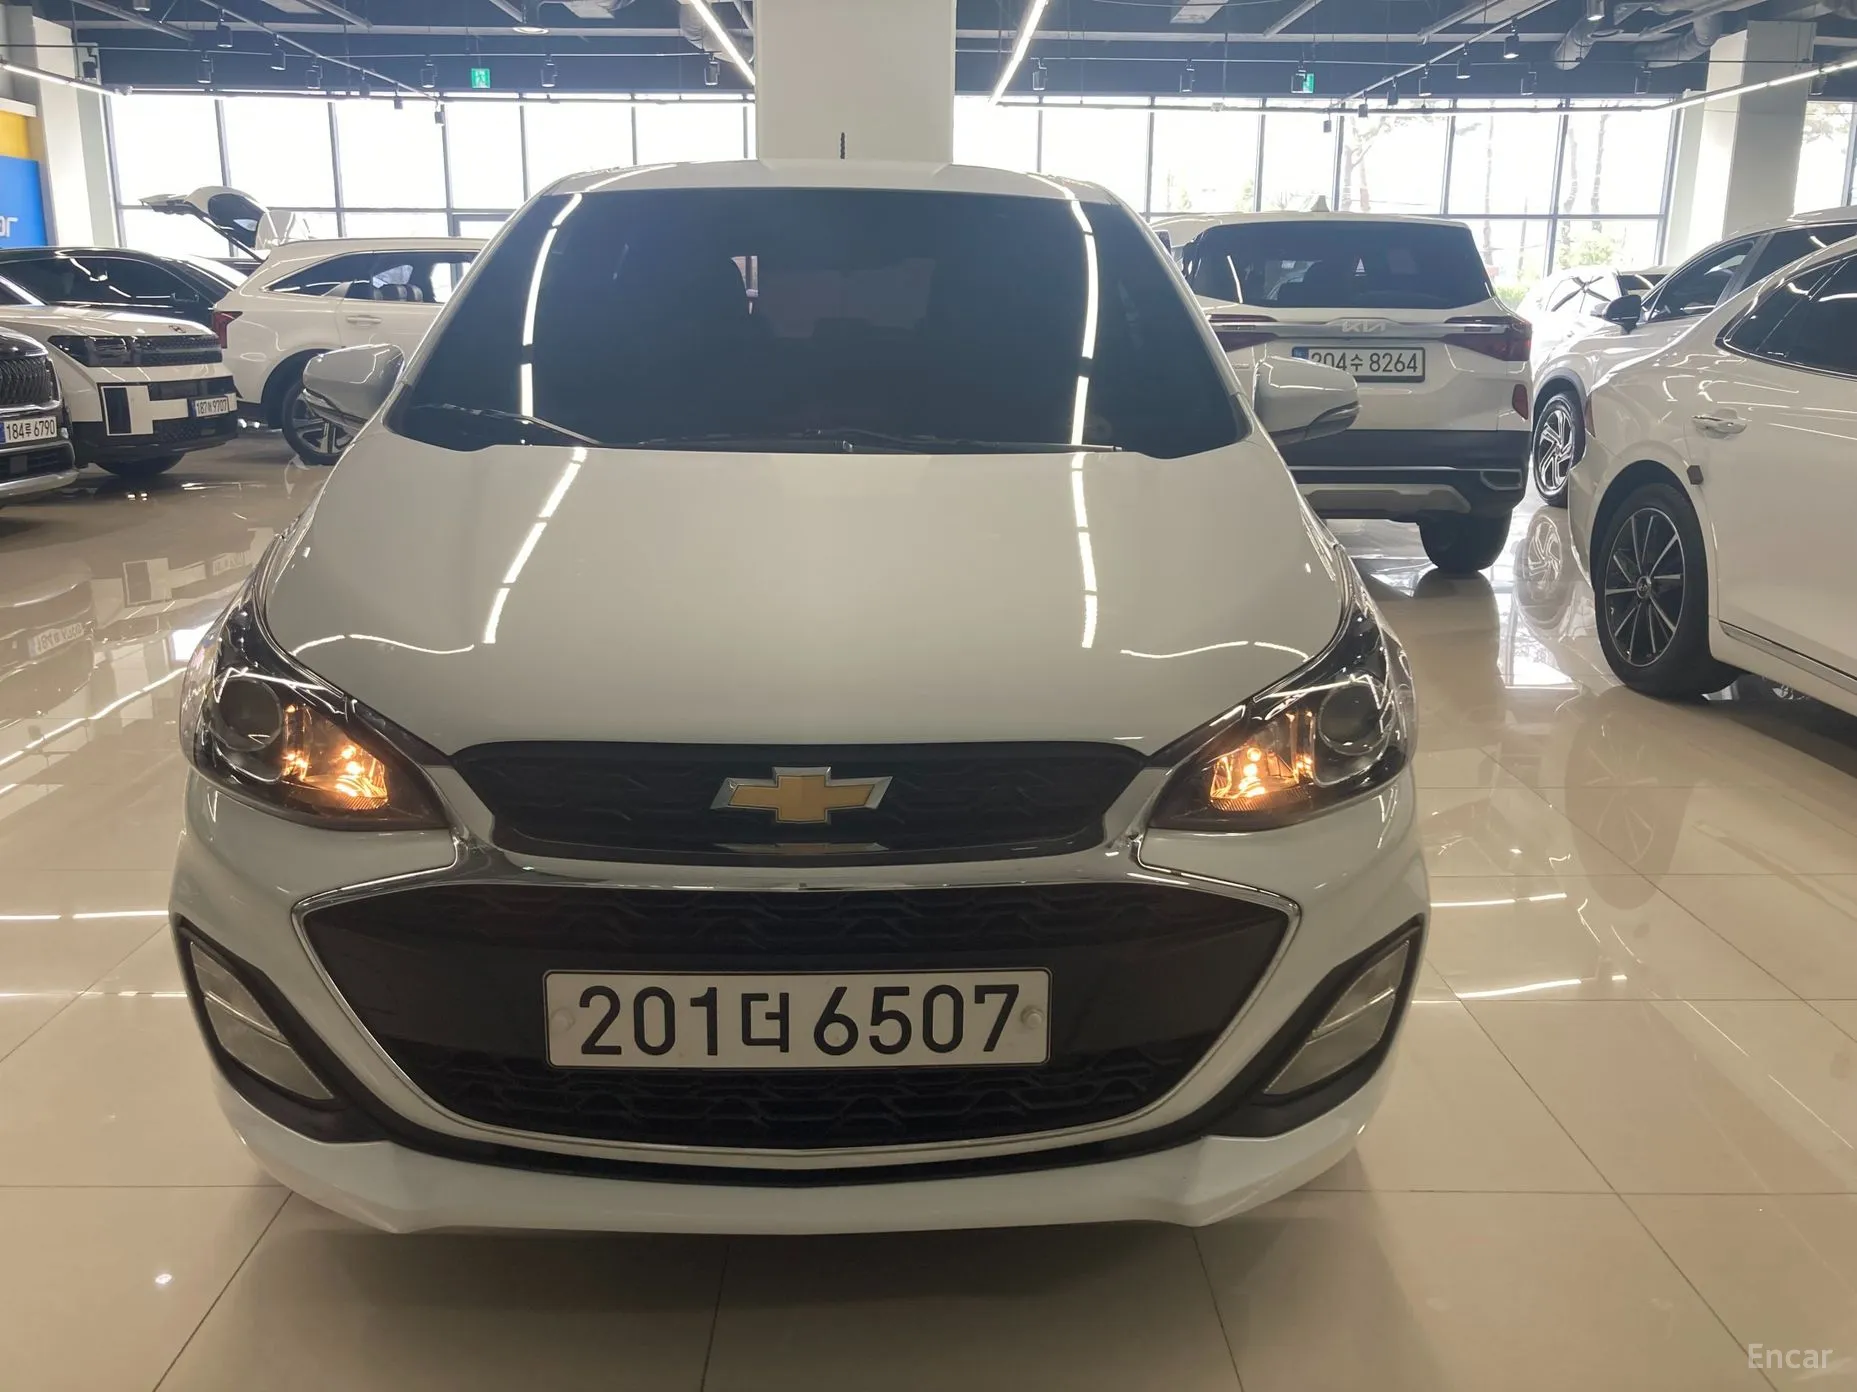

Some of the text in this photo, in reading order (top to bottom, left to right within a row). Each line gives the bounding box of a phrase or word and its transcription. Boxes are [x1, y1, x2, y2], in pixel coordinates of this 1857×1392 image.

[1369, 351, 1418, 373] 8264
[6, 419, 55, 440] 184루 6790
[578, 984, 1020, 1056] 201더 6507
